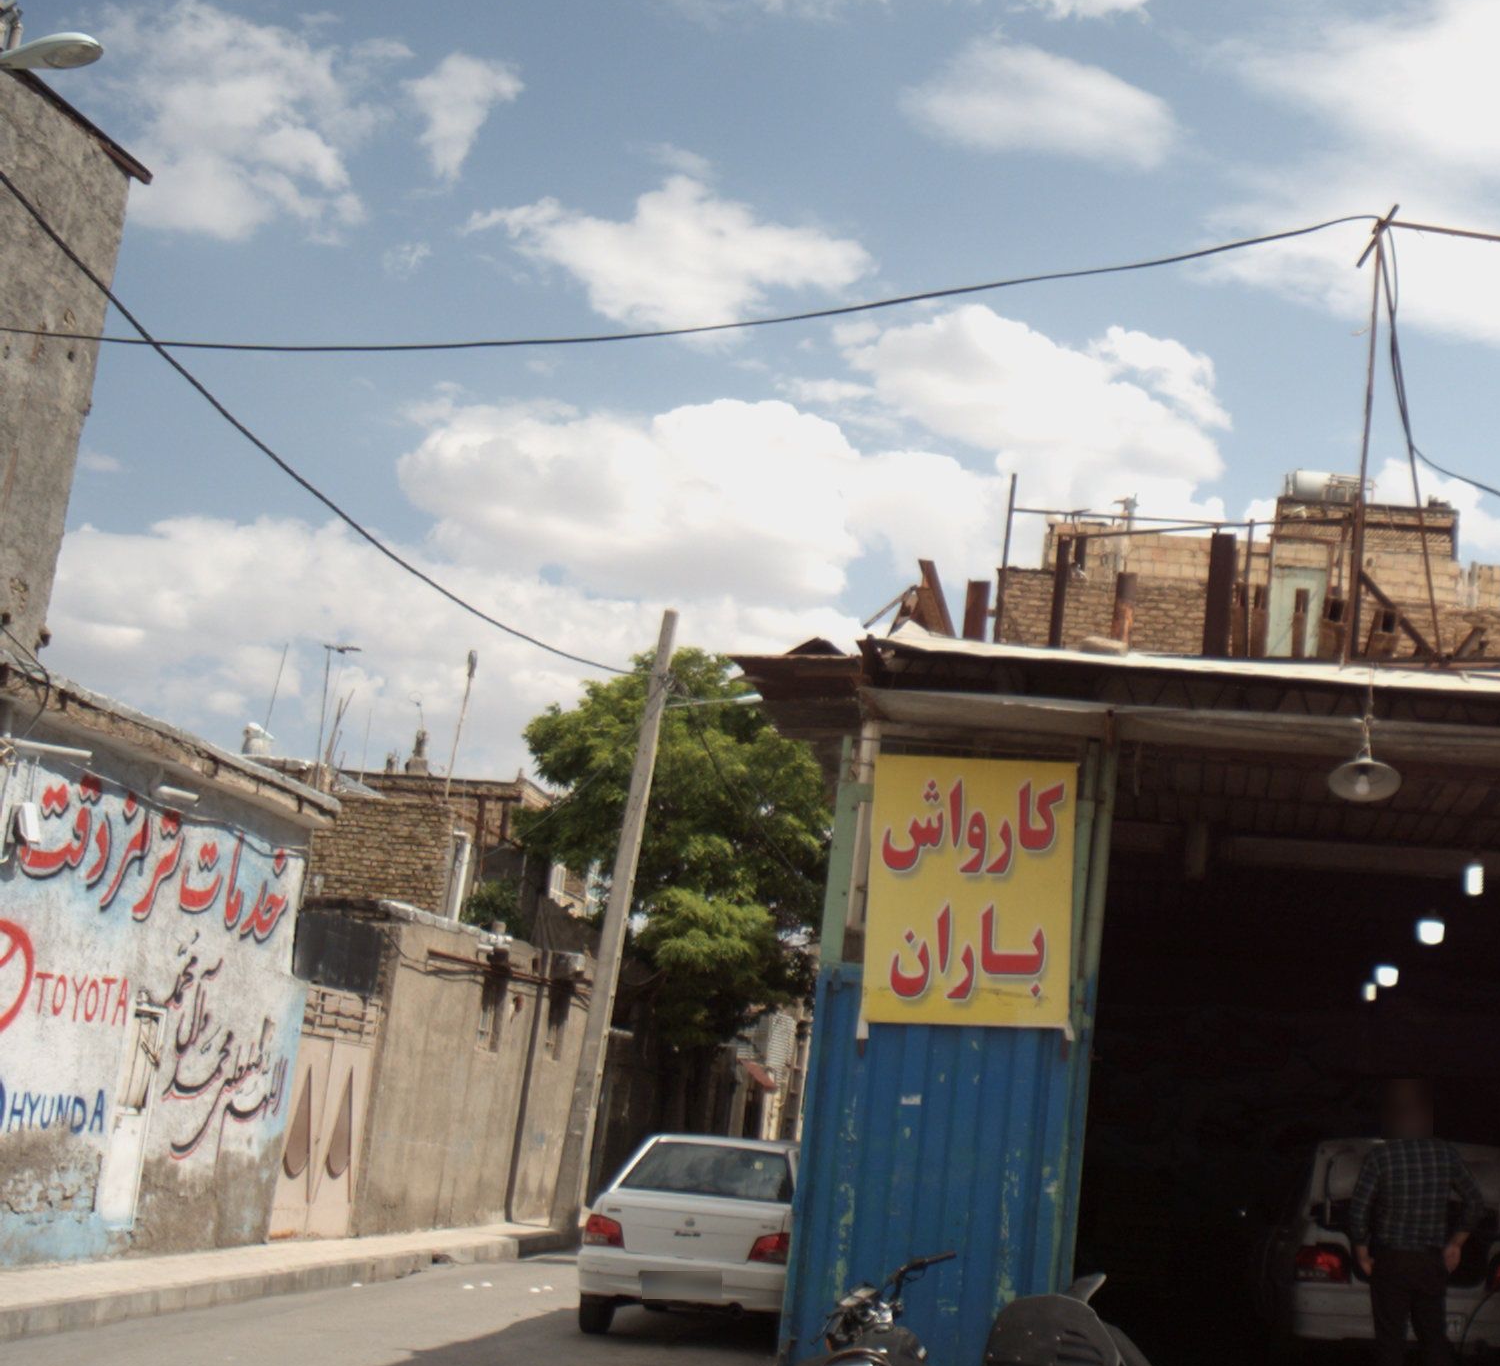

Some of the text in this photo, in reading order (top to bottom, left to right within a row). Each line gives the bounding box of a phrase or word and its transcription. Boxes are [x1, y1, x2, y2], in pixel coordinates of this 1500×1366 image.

[19, 774, 111, 889] دقت
[882, 779, 1065, 874] کارواش
[179, 830, 289, 943] خدمات
[35, 971, 129, 1026] TOYOTA
[890, 903, 1046, 999] باران
